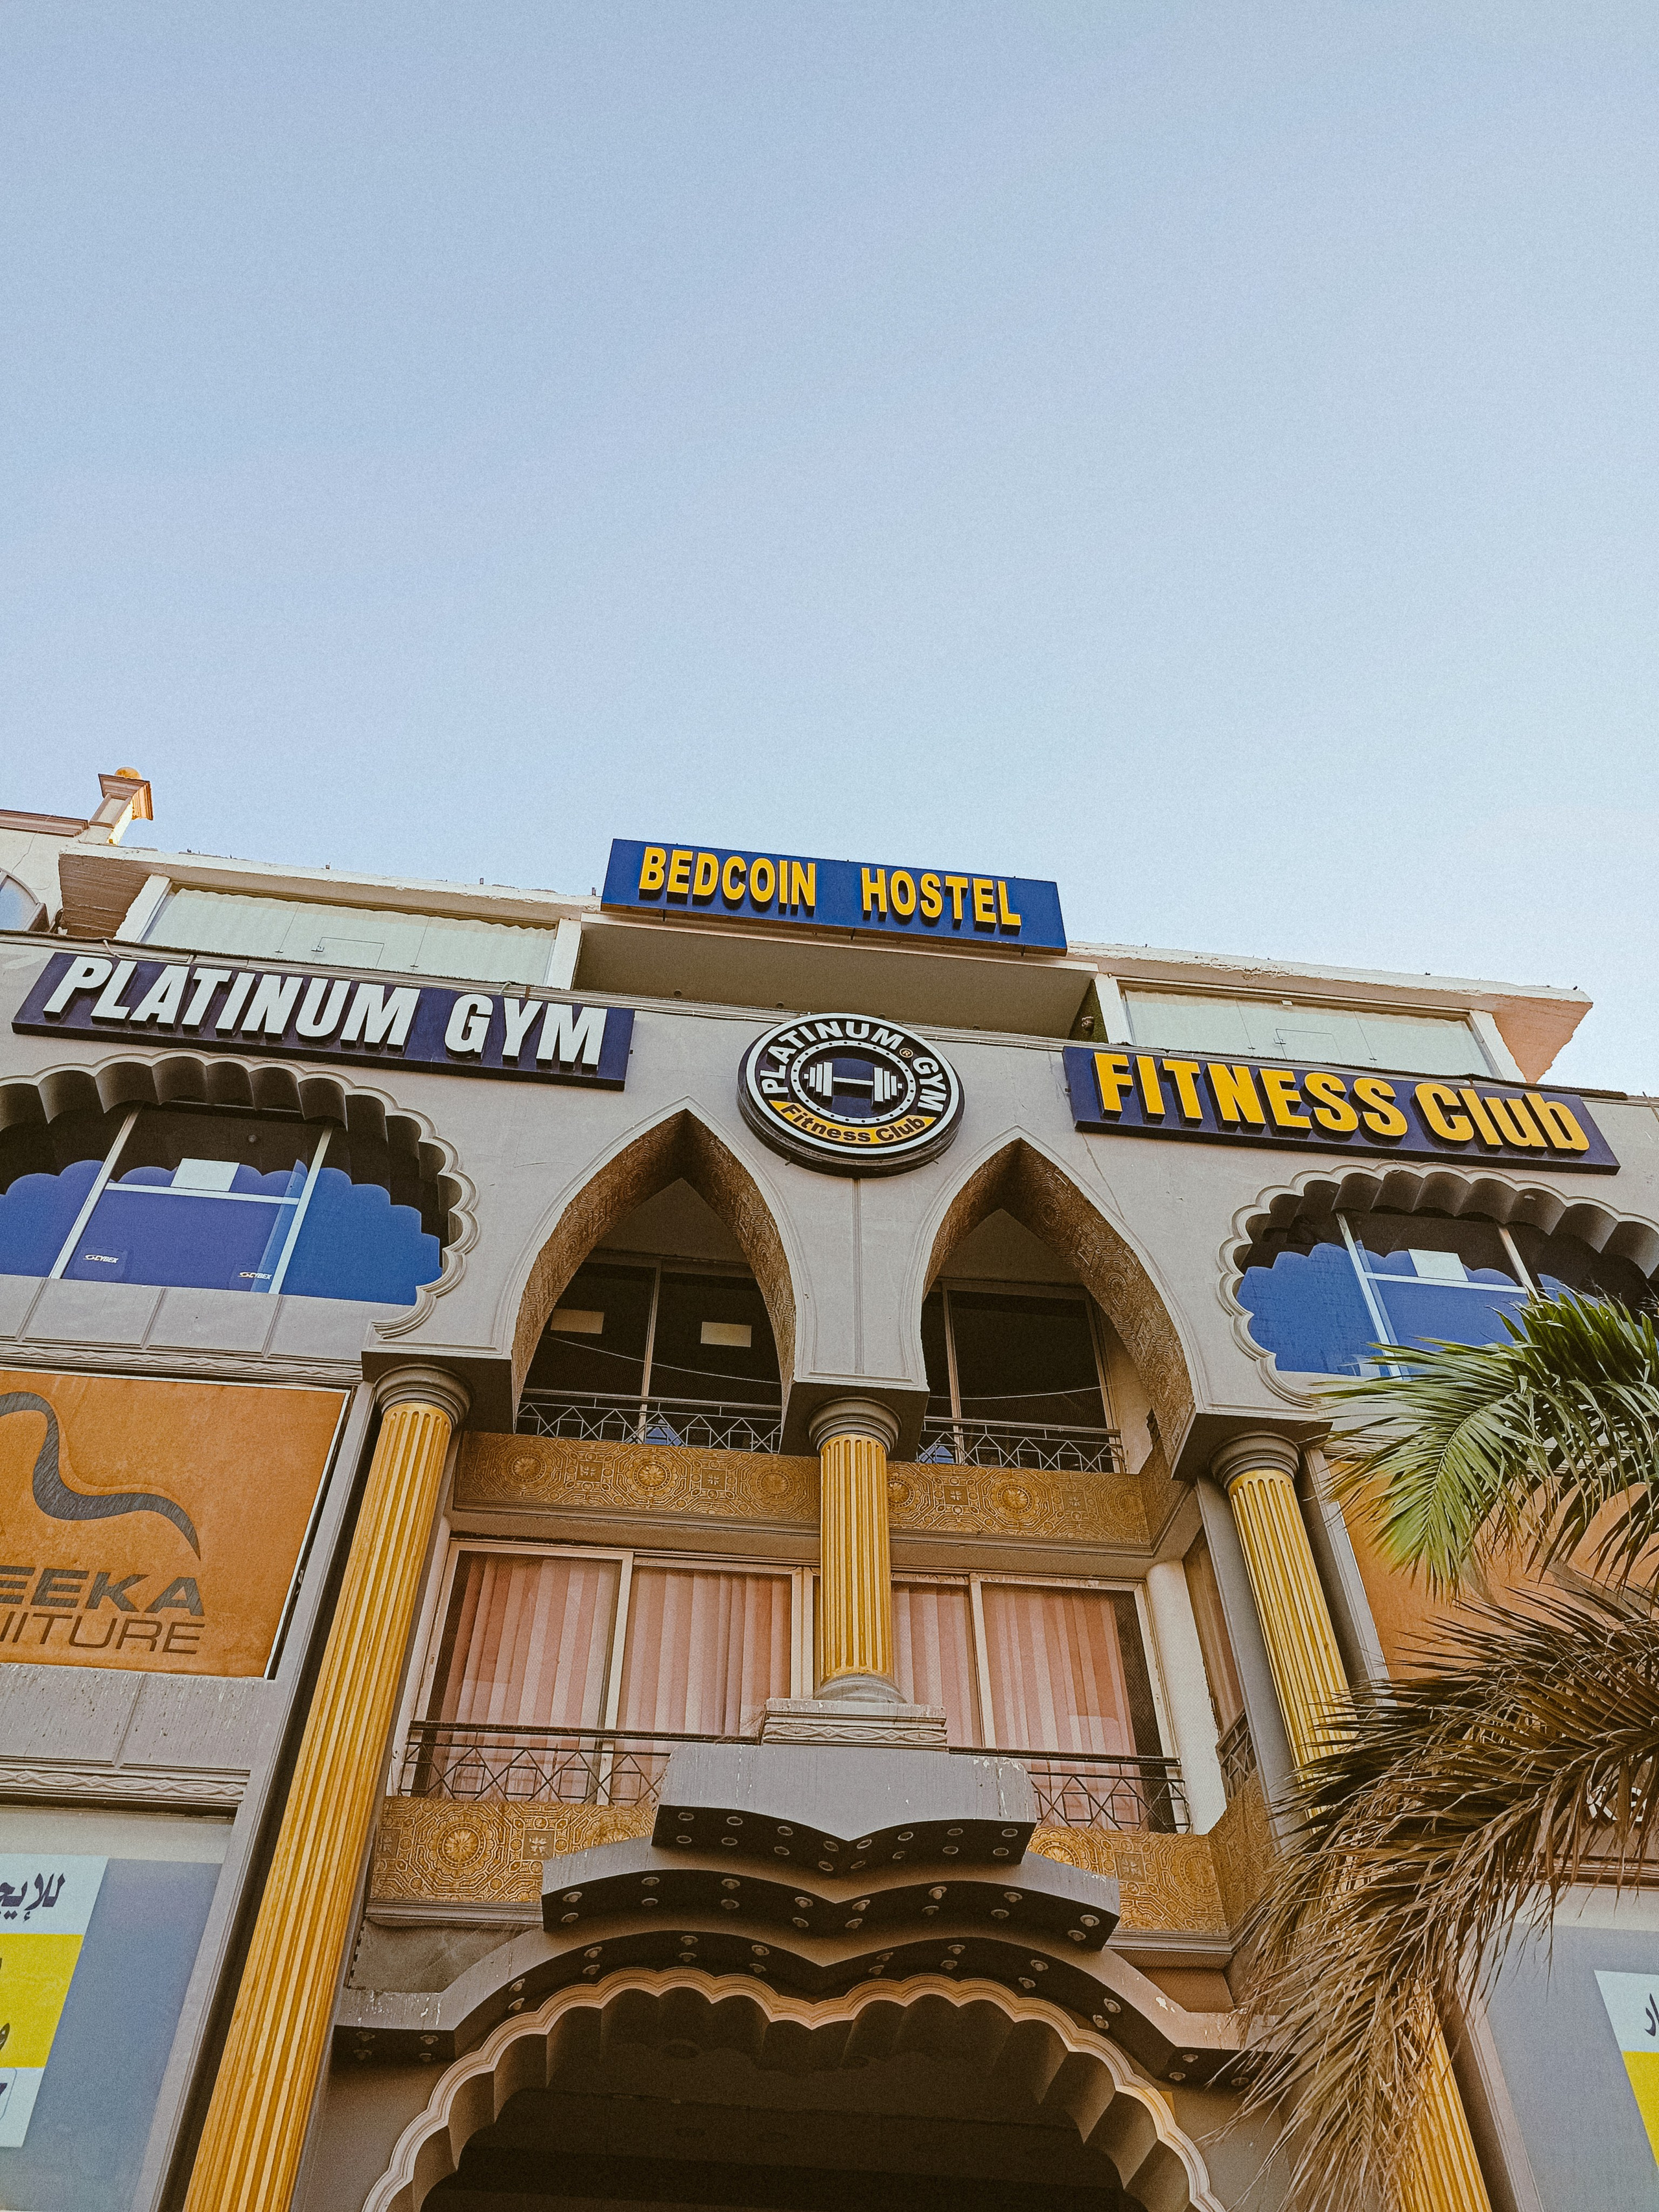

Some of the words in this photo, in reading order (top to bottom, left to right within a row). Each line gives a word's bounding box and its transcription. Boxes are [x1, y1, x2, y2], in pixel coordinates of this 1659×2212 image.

[638, 846, 817, 907] BEDCOIN
[861, 867, 1022, 927] HOSTEL
[43, 956, 421, 1047] PLATINUM
[444, 994, 607, 1066] GYM
[760, 1021, 904, 1094] PLATINUM
[912, 1057, 947, 1112] GYM
[1093, 1052, 1408, 1137] FITNESS
[1414, 1083, 1590, 1152] Club
[780, 1104, 871, 1143] Fitness
[876, 1115, 925, 1142] Club
